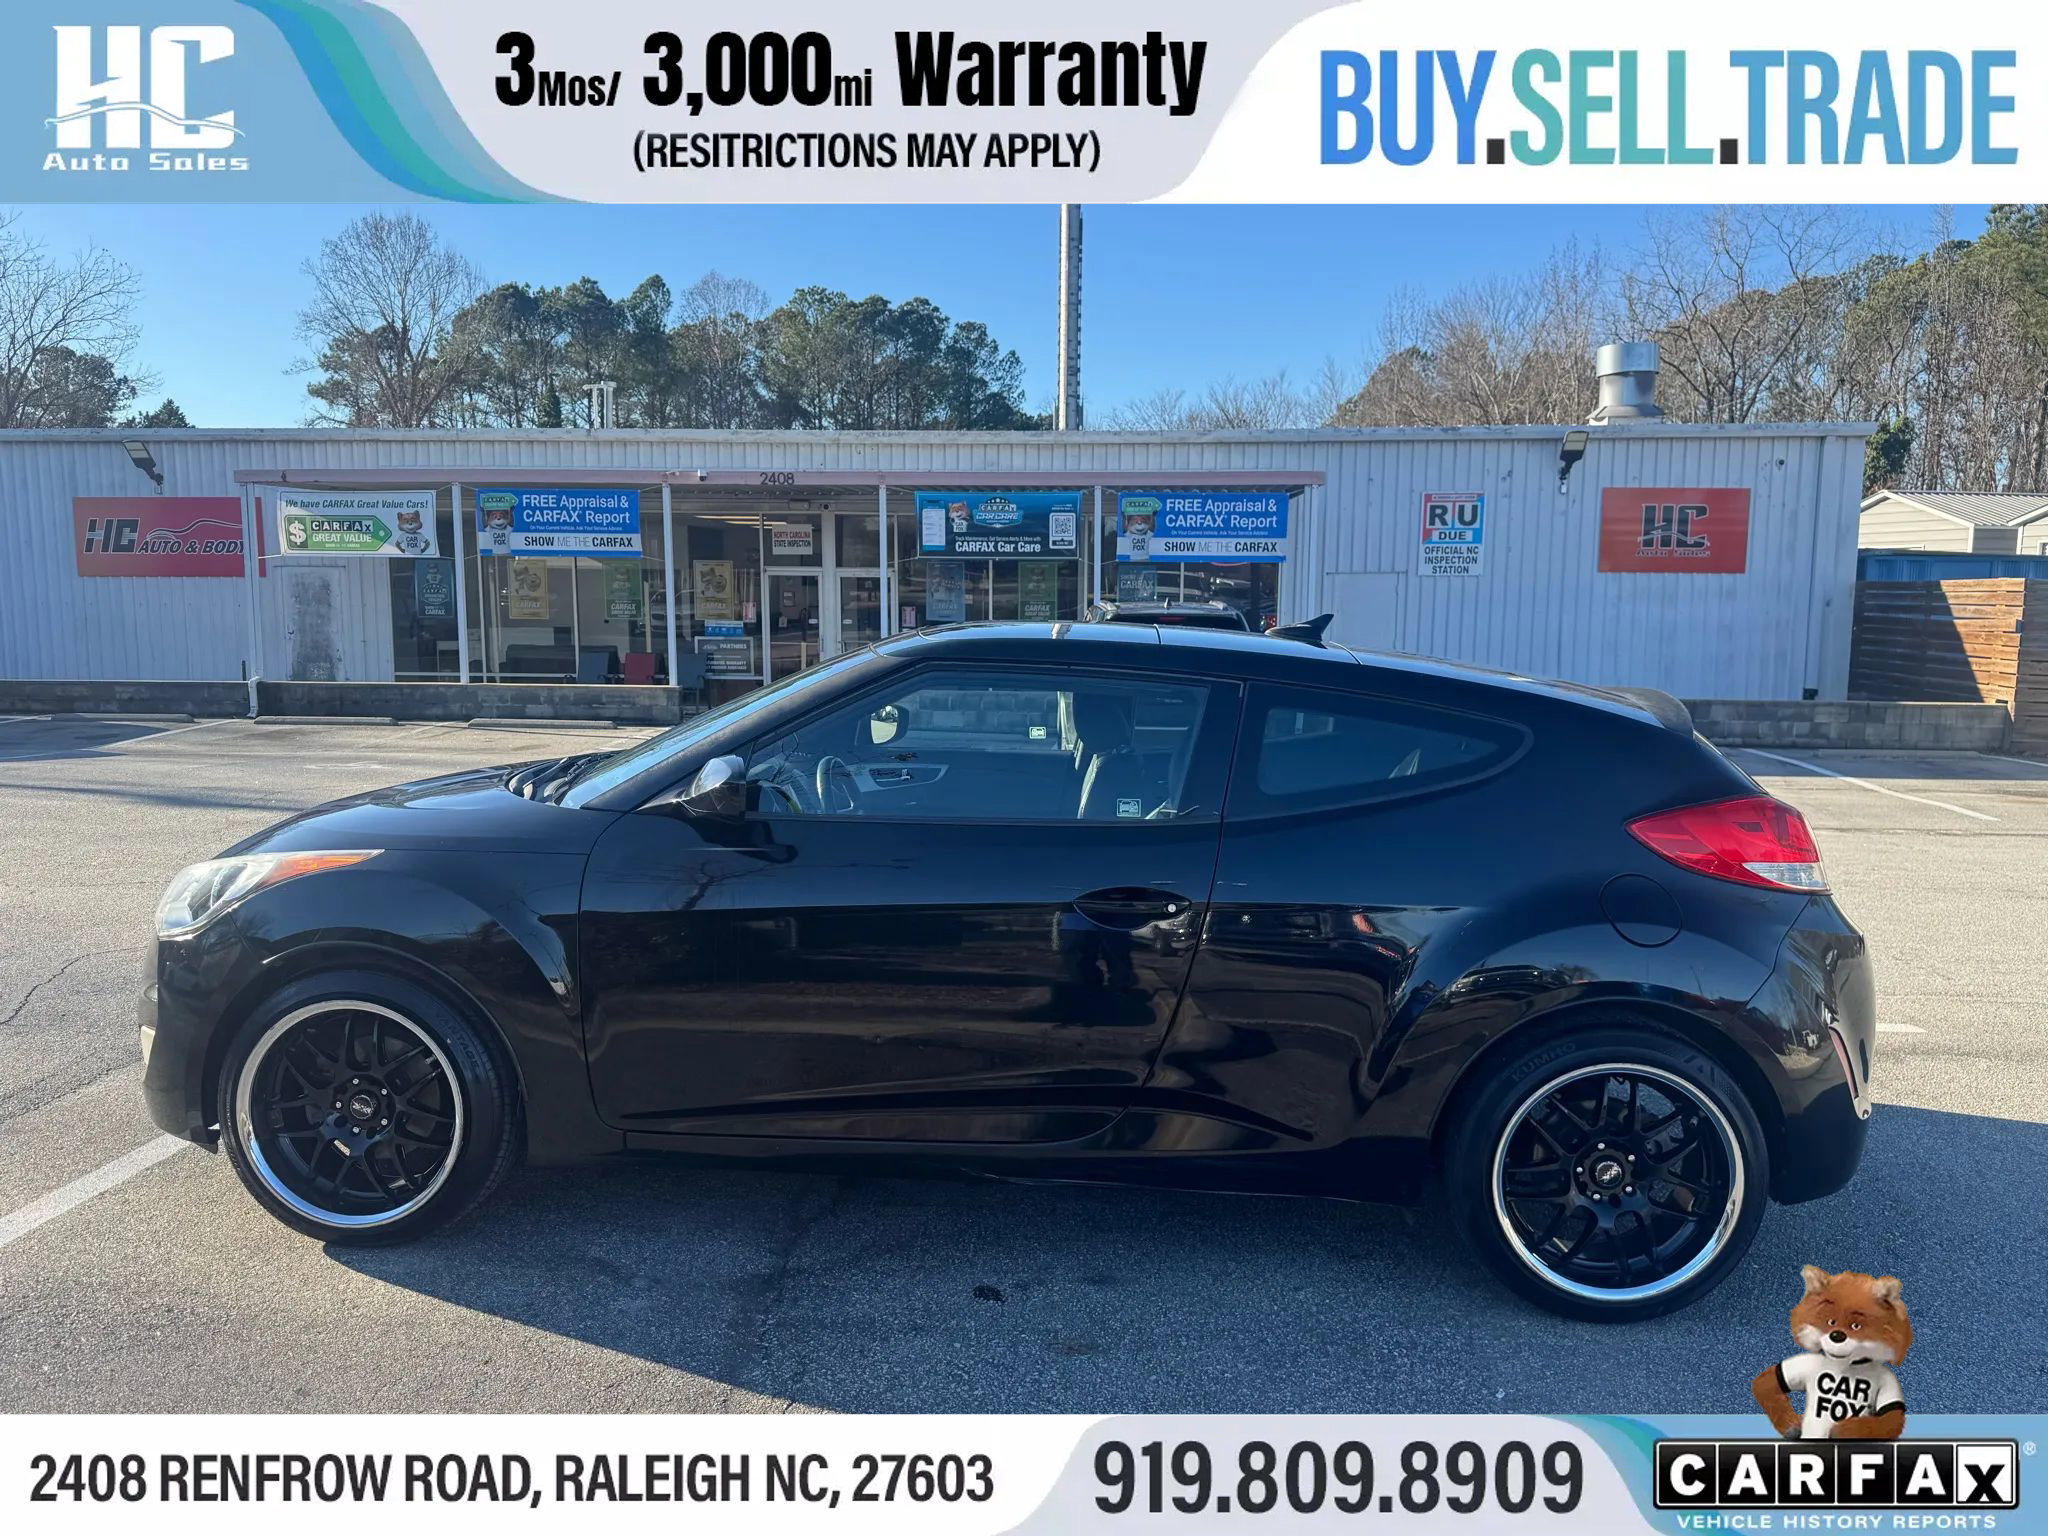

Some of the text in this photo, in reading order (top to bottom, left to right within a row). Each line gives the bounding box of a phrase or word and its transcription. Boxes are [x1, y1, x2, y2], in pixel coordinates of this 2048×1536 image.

[760, 472, 795, 486] 2408
[285, 500, 428, 509] We have CARFAX Great Value Cars!
[522, 495, 557, 507] FREE
[560, 495, 617, 509] Appraisal
[620, 496, 629, 508] &
[1166, 499, 1201, 511] FREE
[1204, 499, 1266, 514] Appraisal
[1268, 500, 1277, 511] &
[523, 510, 630, 526] CARFAX Report
[1165, 514, 1278, 530] CARFAX Report
[311, 521, 372, 532] CARFAX
[1641, 504, 1709, 549] HC
[312, 533, 372, 542] GREAT VALUE
[1438, 531, 1466, 540] DUE
[136, 540, 182, 554] AUTO
[184, 540, 199, 554] &
[524, 536, 633, 548] SHOW ME THE CARFAX
[955, 541, 1041, 552] CARFAX Car Care
[1164, 541, 1277, 553] SHOW ME THE CARFAX
[1424, 546, 1479, 555] OFFICIAL NC
[1424, 556, 1478, 565] INSPECTION
[1432, 565, 1470, 575] STATION
